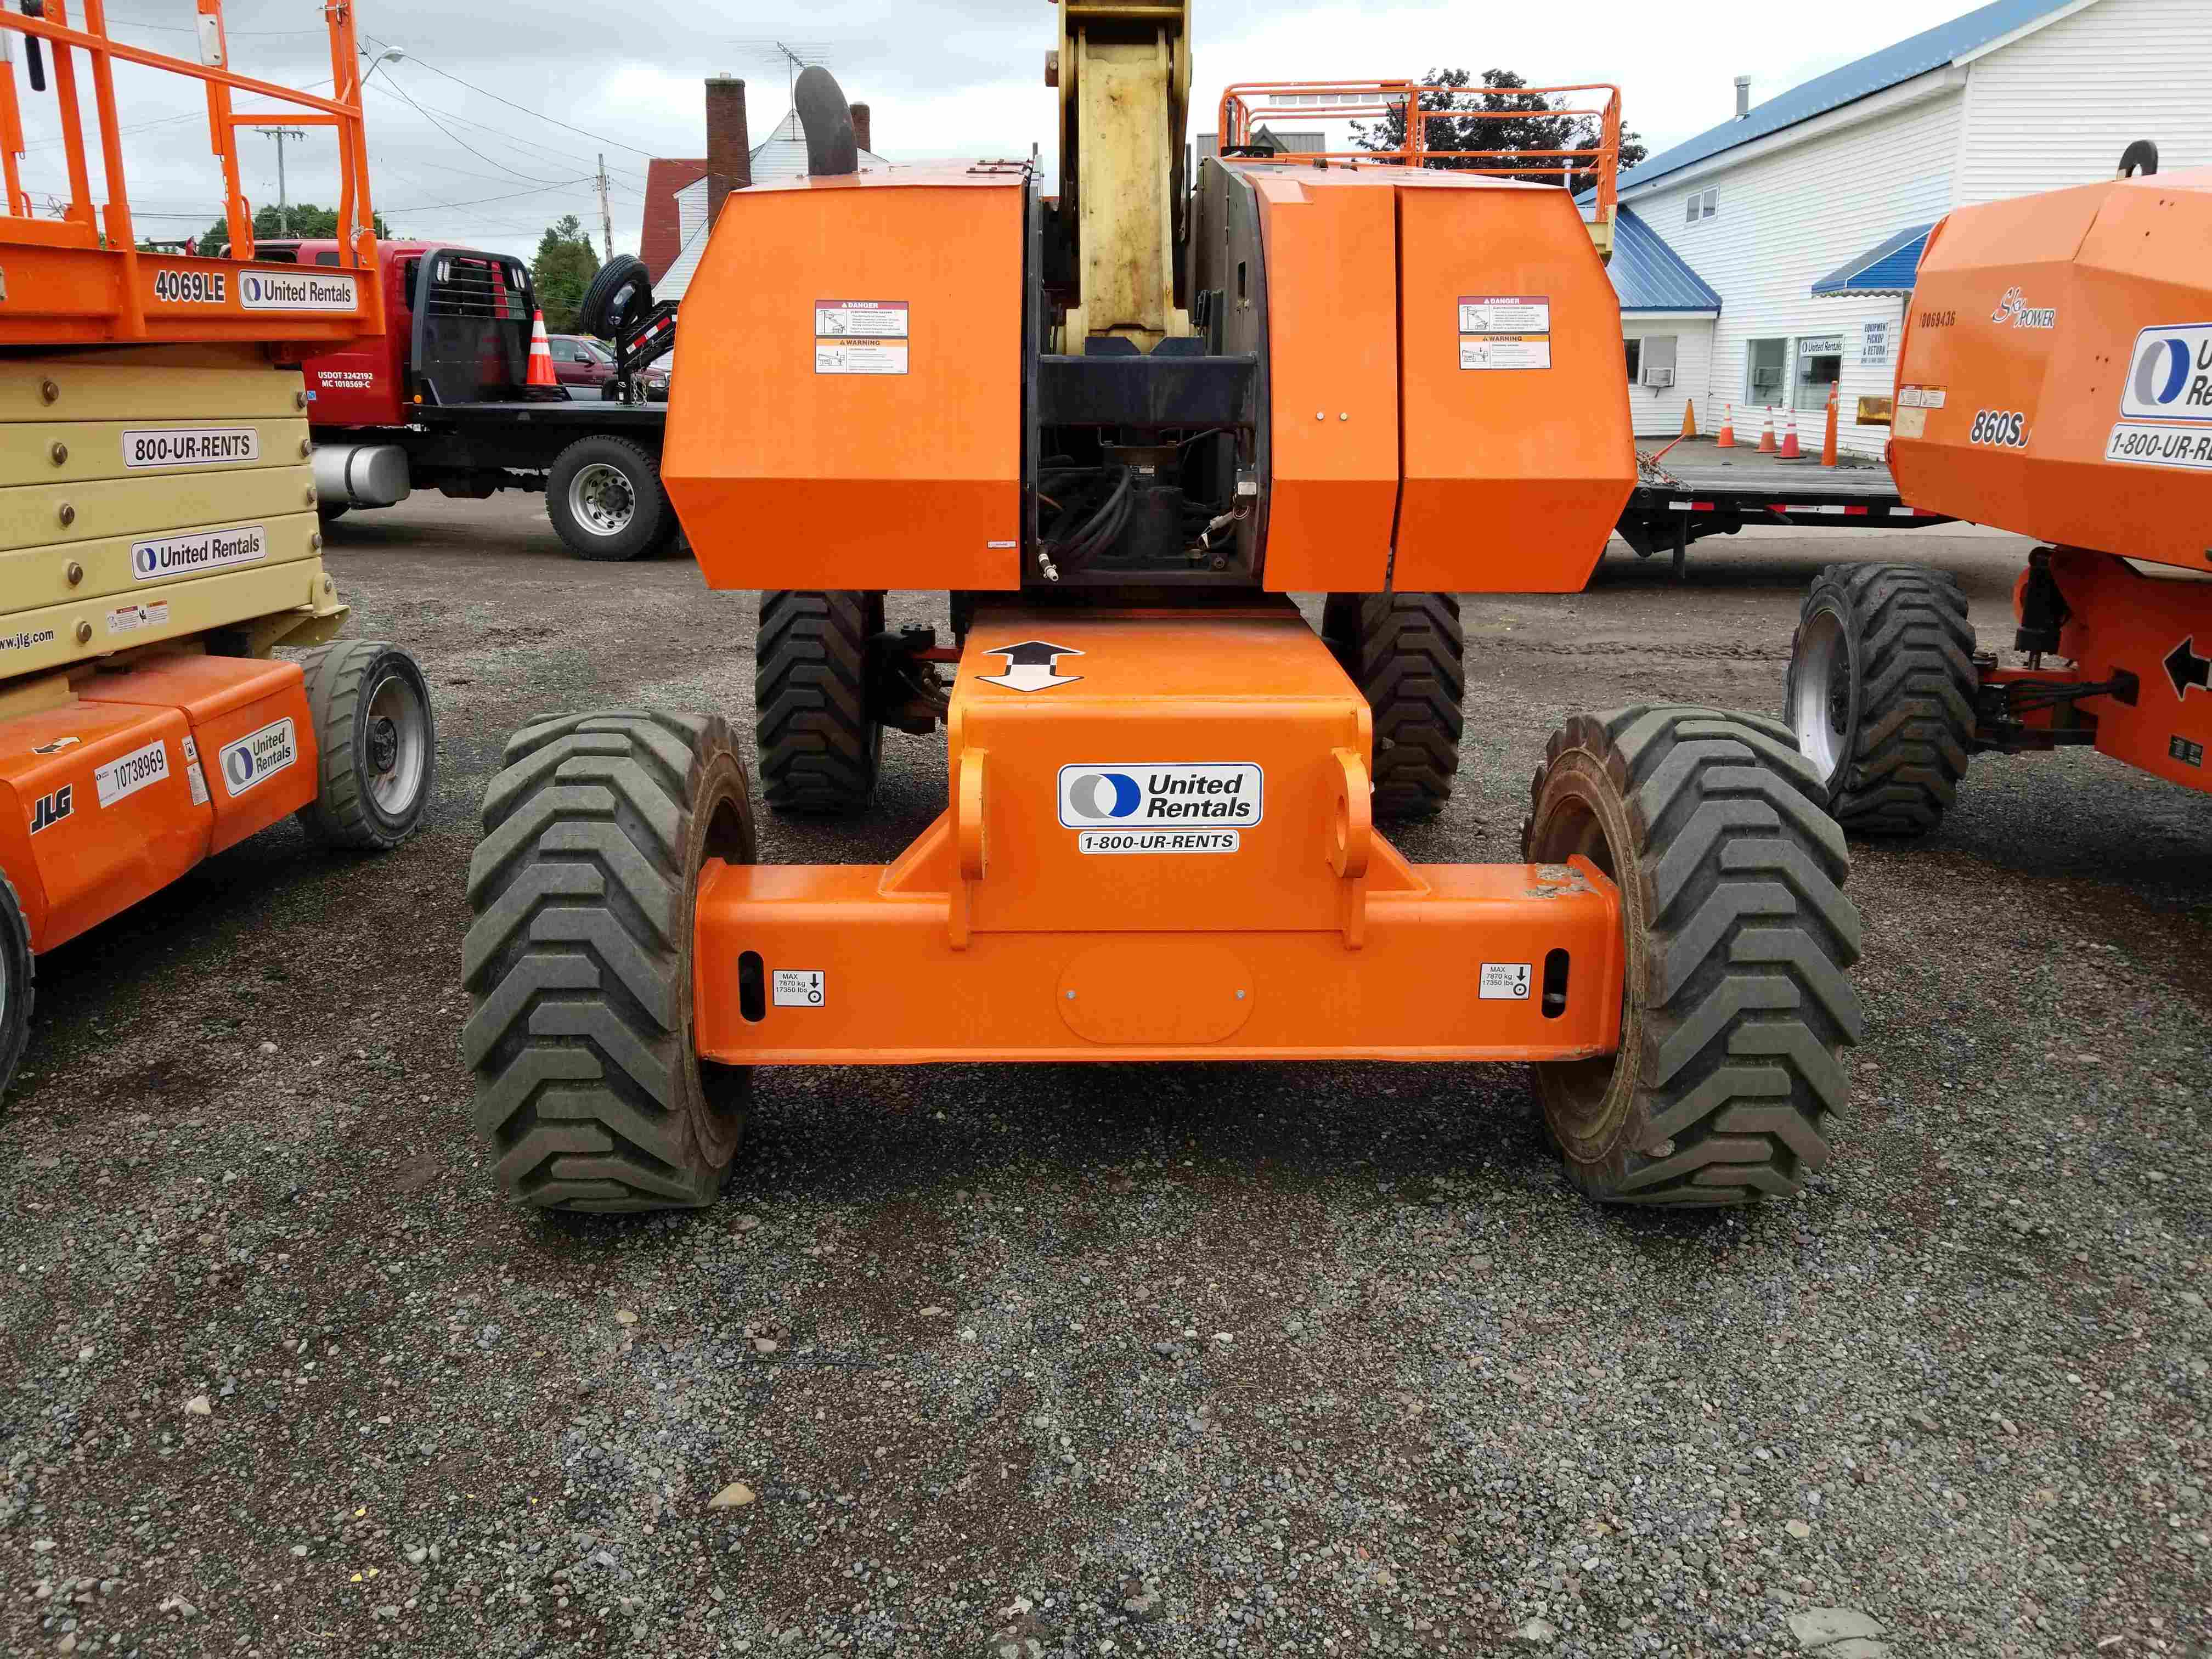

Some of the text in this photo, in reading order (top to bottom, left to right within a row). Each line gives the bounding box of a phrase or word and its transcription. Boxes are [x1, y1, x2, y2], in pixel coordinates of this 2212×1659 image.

[155, 270, 225, 302] 4069LE
[264, 279, 351, 303] United Rentals
[1865, 323, 1888, 332] EQUIPMENT
[2019, 309, 2055, 328] POWER
[1808, 340, 1842, 352] United Rentals
[1866, 334, 1884, 344] PICKUP
[1867, 346, 1886, 356] RETURN
[136, 435, 250, 460] 800-UR-RENTS
[160, 533, 259, 567] United Rentals
[253, 727, 285, 756] United
[114, 749, 164, 790] 10738969
[256, 744, 291, 774] Rentals
[1148, 773, 1243, 795] United
[30, 783, 72, 835] JLG
[1147, 797, 1251, 818] Rentals
[1085, 834, 1233, 849] 1-800-UR-RENTS
